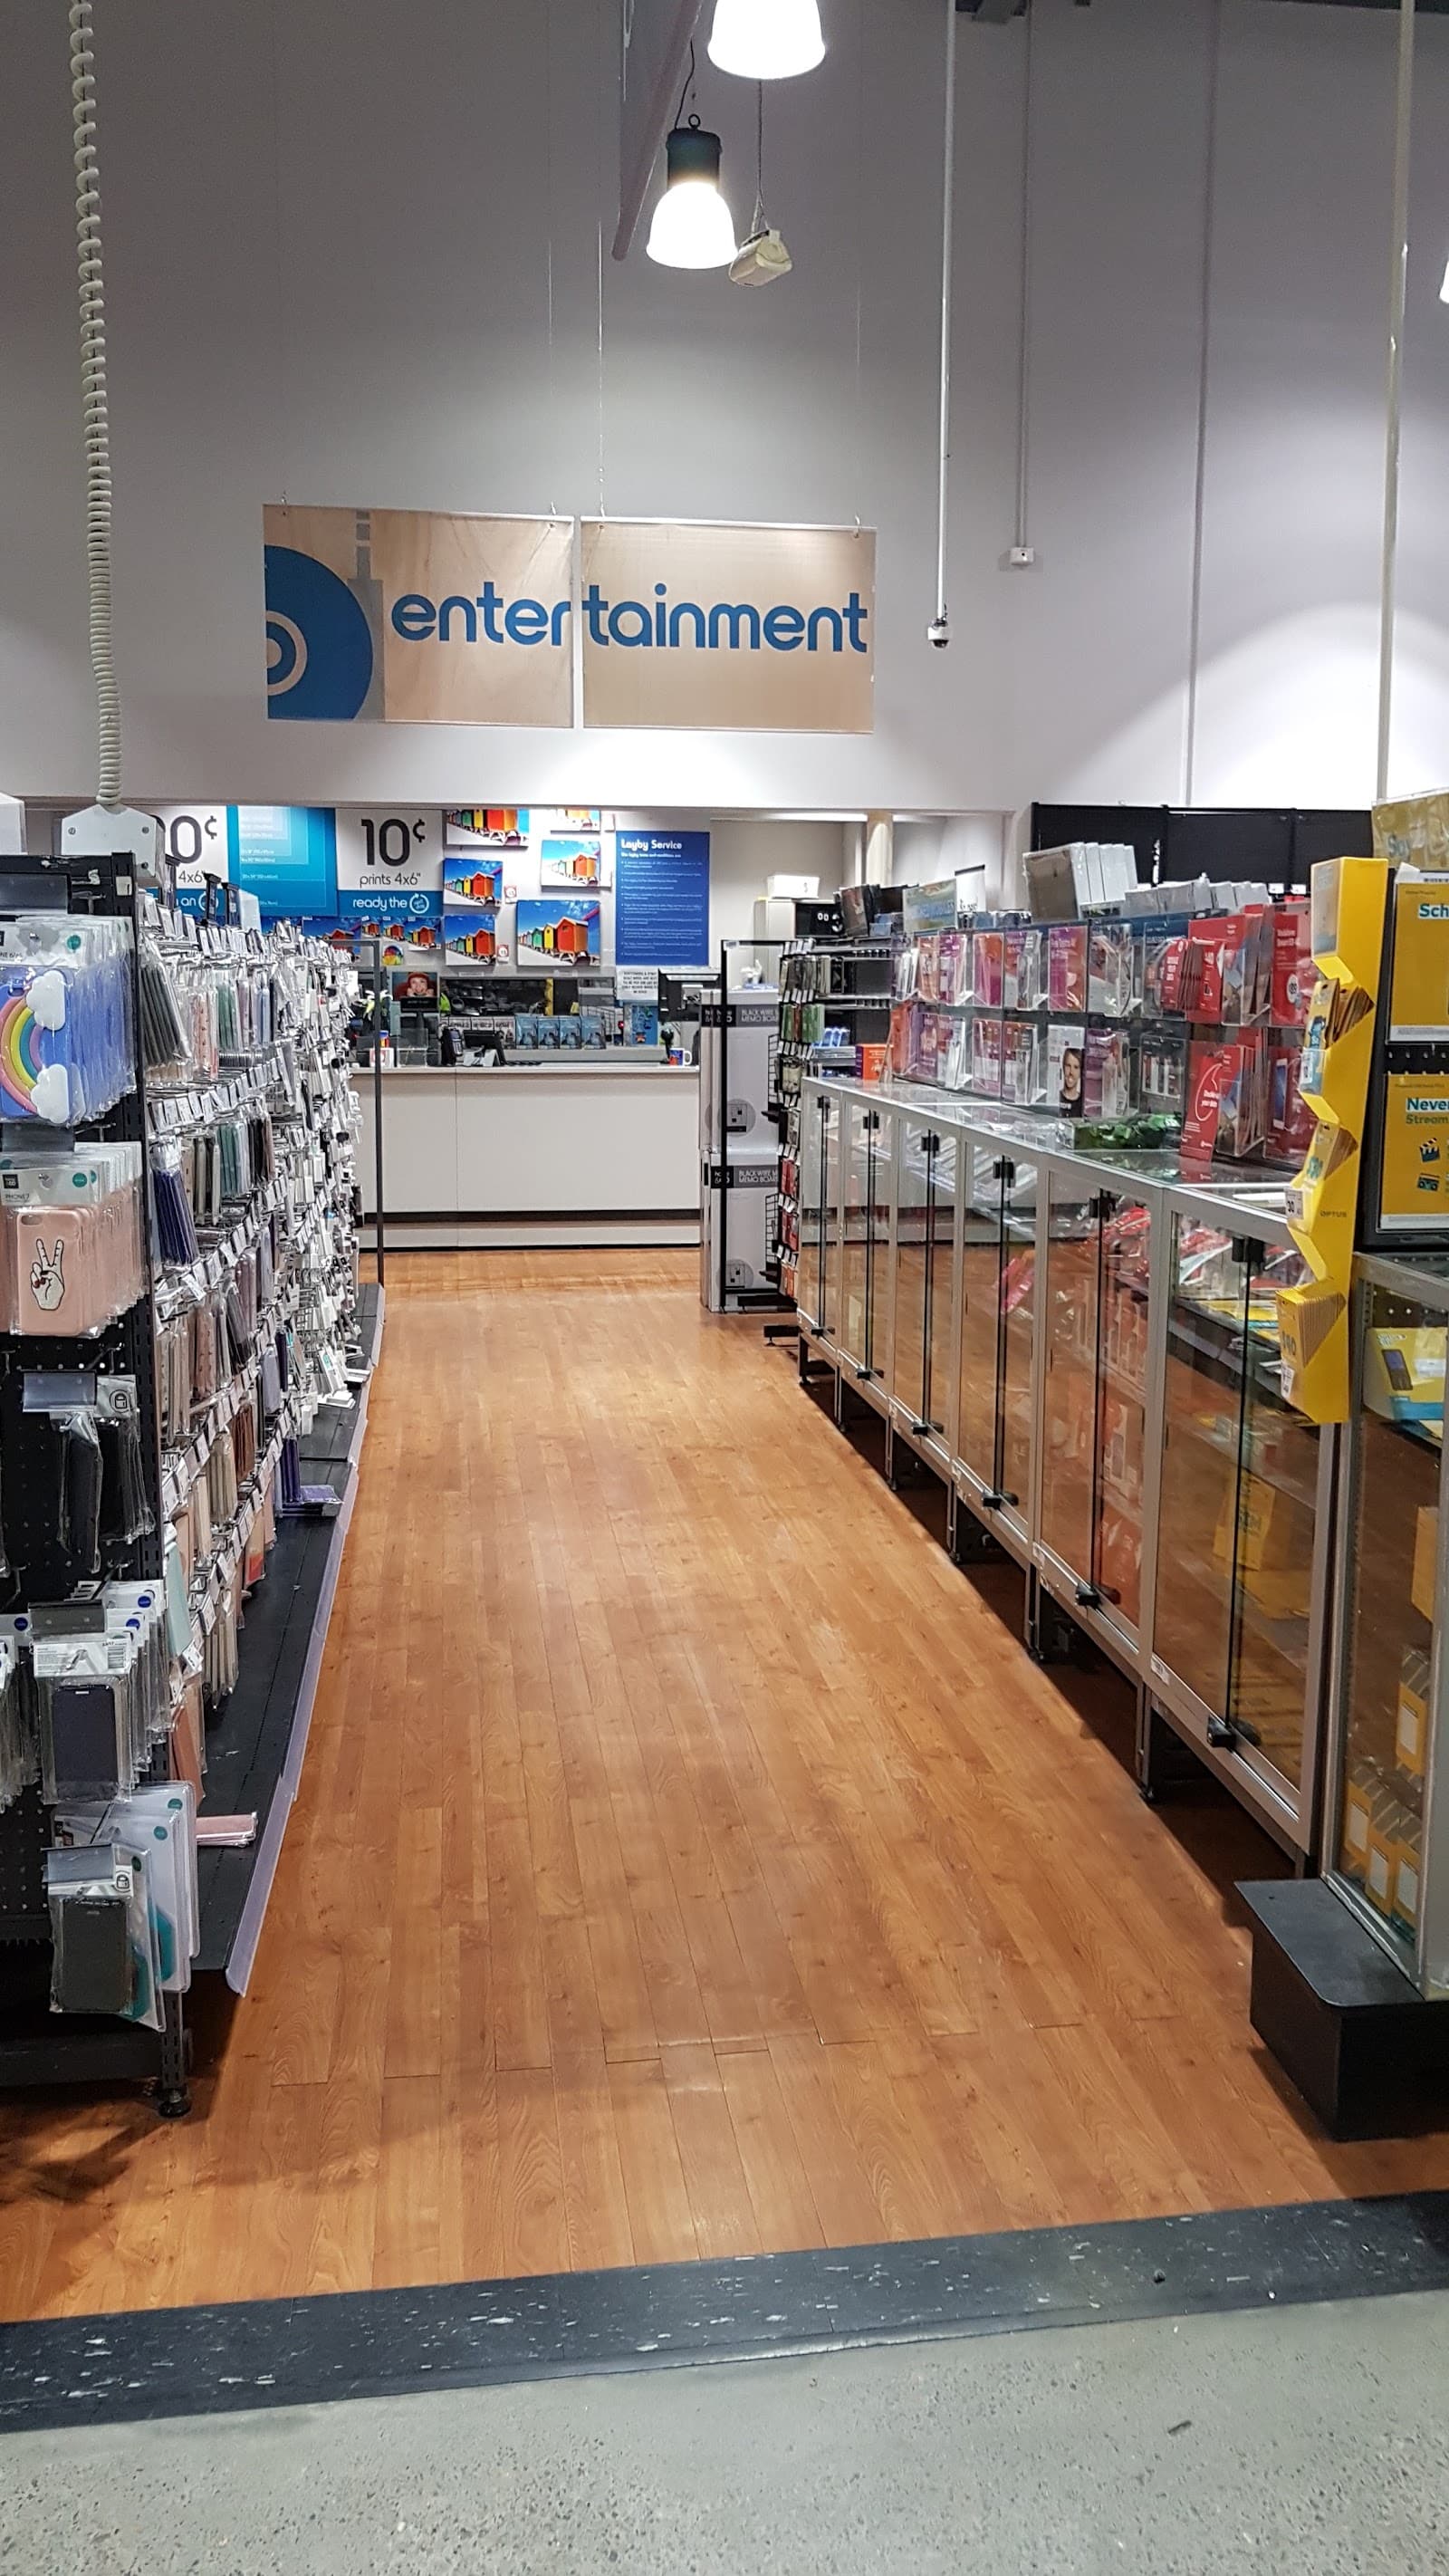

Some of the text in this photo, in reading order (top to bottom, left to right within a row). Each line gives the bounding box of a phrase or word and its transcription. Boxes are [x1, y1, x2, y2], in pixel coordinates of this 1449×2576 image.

[391, 582, 868, 653] entertainment
[169, 815, 217, 864] 0¢
[361, 819, 426, 867] 10¢
[620, 839, 683, 851] Layby Service
[360, 872, 421, 889] prints 4x6"
[352, 896, 388, 911] ready
[389, 896, 408, 908] the
